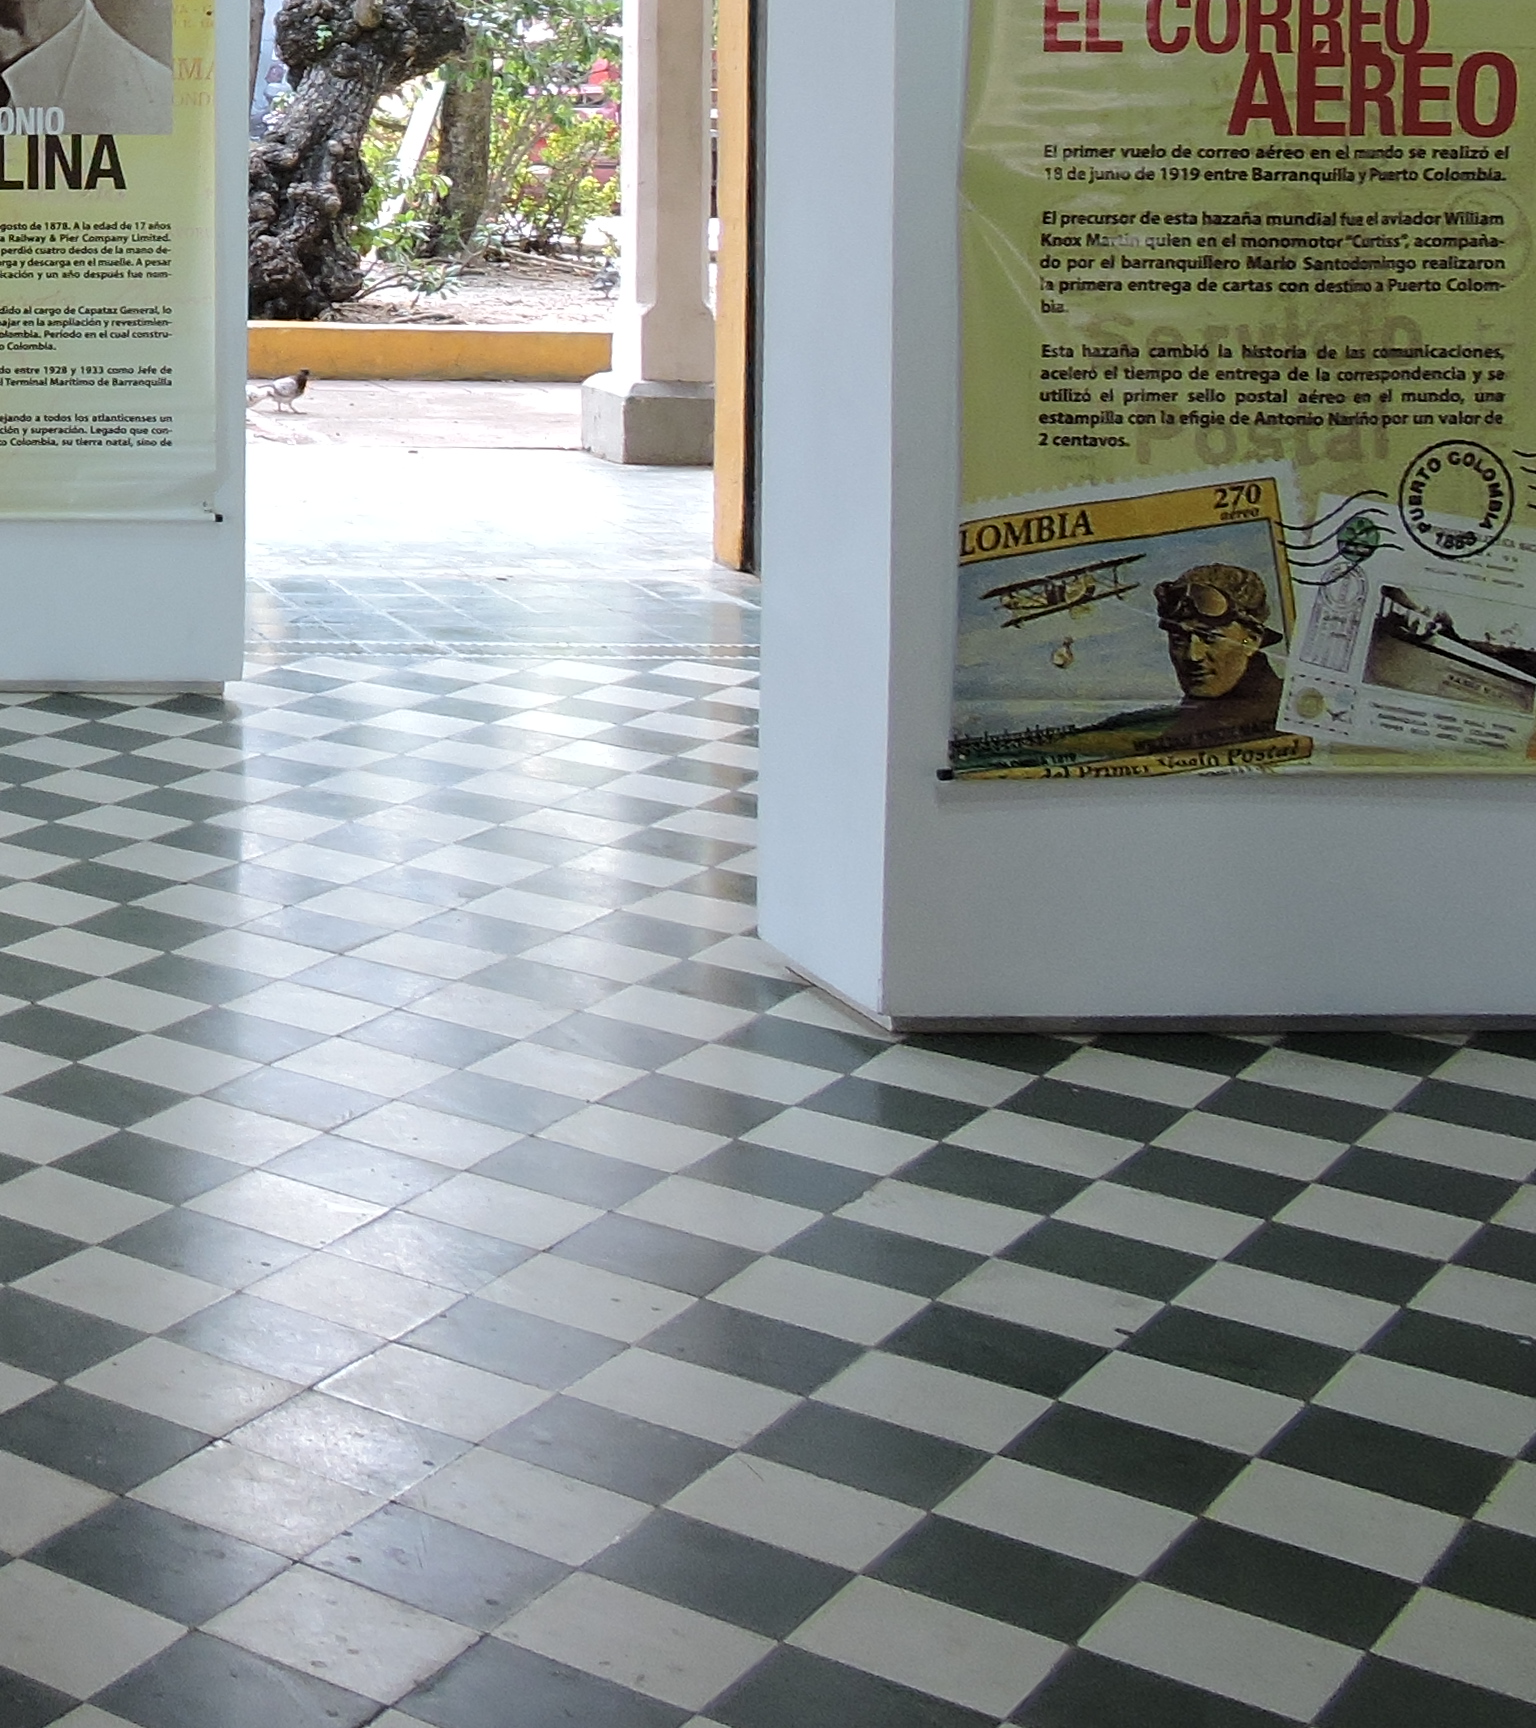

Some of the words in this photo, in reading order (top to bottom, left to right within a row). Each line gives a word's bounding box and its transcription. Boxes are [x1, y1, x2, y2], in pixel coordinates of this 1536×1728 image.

[1227, 40, 1518, 138] AÉREO
[1062, 145, 1116, 162] primer
[1120, 145, 1166, 159] vuelo
[1171, 145, 1192, 159] de
[1196, 148, 1249, 159] correo
[1255, 145, 1304, 159] aéreo
[1309, 148, 1331, 159] en
[1335, 145, 1349, 160] el
[1408, 149, 1427, 160] se
[1431, 146, 1489, 160] realizó
[1494, 146, 1509, 160] el
[1067, 166, 1086, 181] de
[1134, 167, 1155, 181] de
[1160, 167, 1200, 181] 1919
[1204, 167, 1248, 181] entre
[1251, 167, 1355, 185] Barranquilla
[1369, 167, 1418, 182] Puerto
[1422, 167, 1507, 182] Colombia.
[6, 342, 57, 351] Colombia.
[1212, 483, 1262, 509] 270
